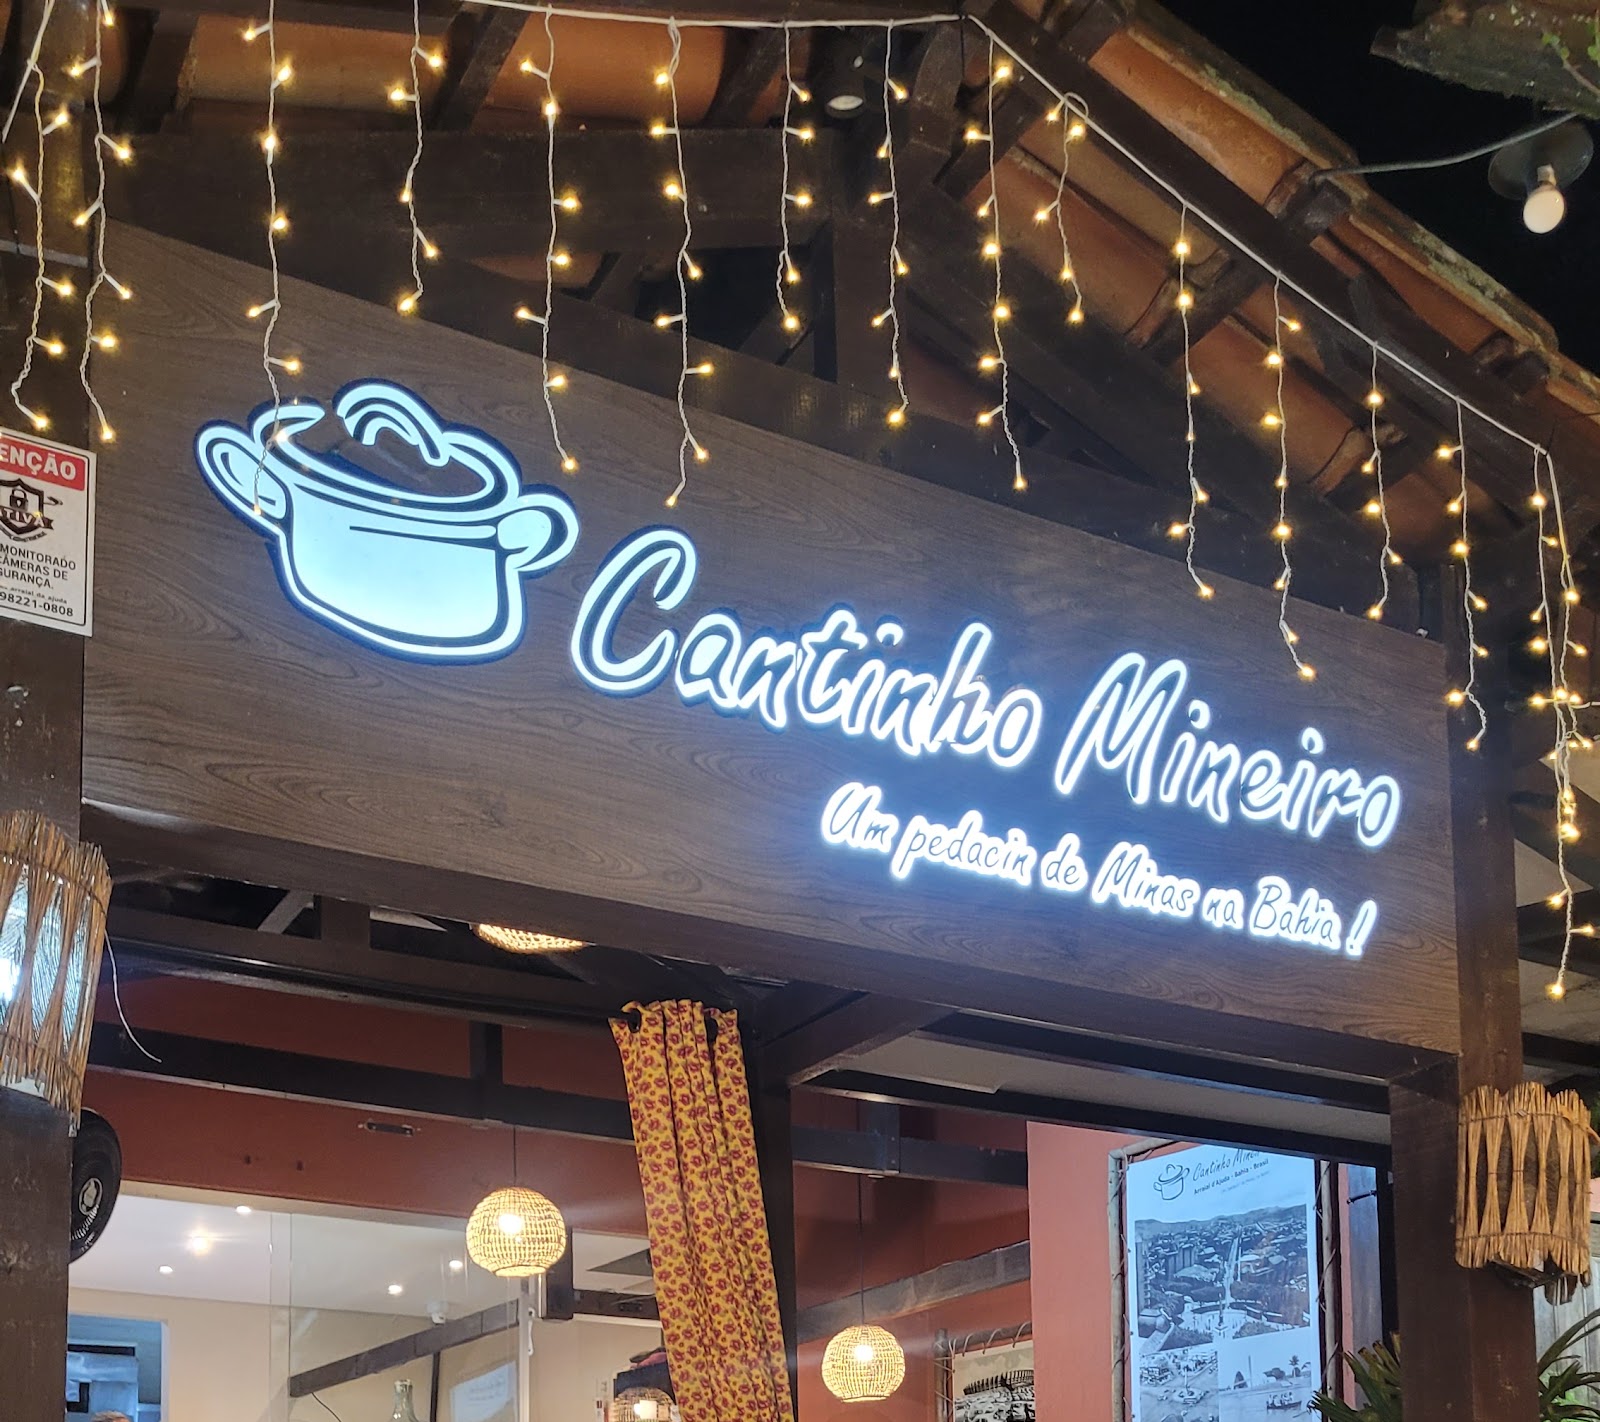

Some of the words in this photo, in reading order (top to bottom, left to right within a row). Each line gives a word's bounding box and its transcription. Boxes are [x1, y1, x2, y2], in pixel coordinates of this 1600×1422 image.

[0, 544, 76, 570] MONITORADO
[53, 569, 68, 581] DE
[570, 530, 1043, 769] Cantinho
[1055, 653, 1402, 848] Mineiro
[824, 784, 897, 850] Um
[893, 812, 1034, 884] pedacin
[1043, 835, 1086, 889] de
[1094, 843, 1198, 914] Minas
[1204, 889, 1243, 927] na
[1252, 878, 1340, 946] Bahia
